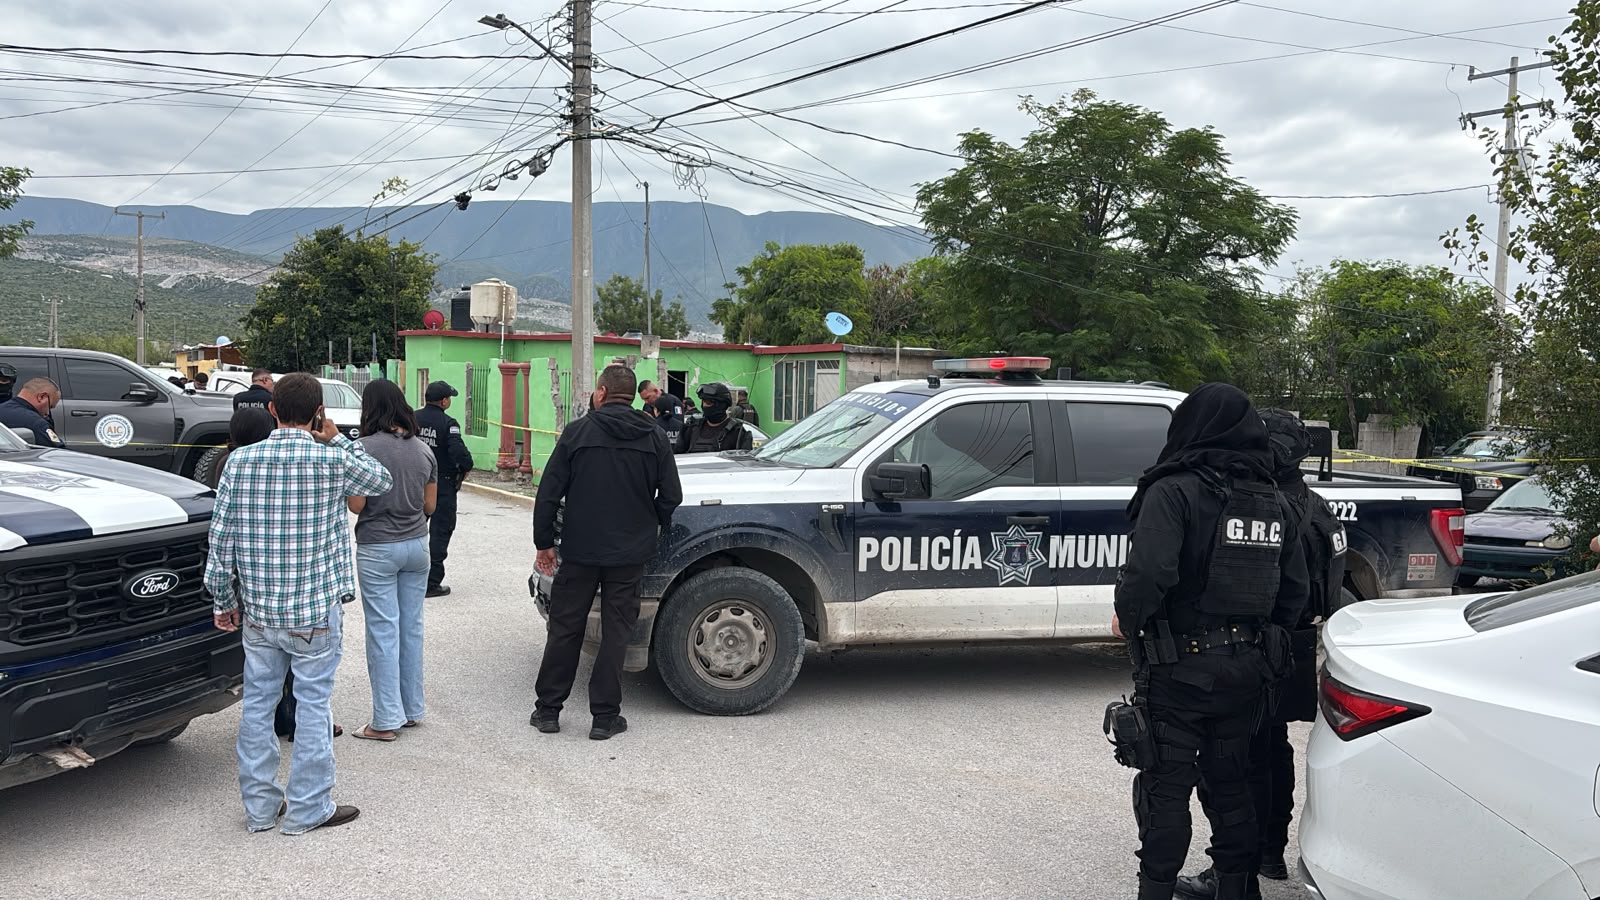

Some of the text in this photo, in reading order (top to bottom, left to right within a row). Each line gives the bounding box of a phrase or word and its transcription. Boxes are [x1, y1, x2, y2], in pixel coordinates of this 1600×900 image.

[237, 401, 265, 409] POLICÍA
[107, 426, 123, 434] AIC
[858, 528, 1133, 572] POLICÍA MUNI
[1410, 556, 1433, 565] 911
[140, 575, 171, 595] Ford
